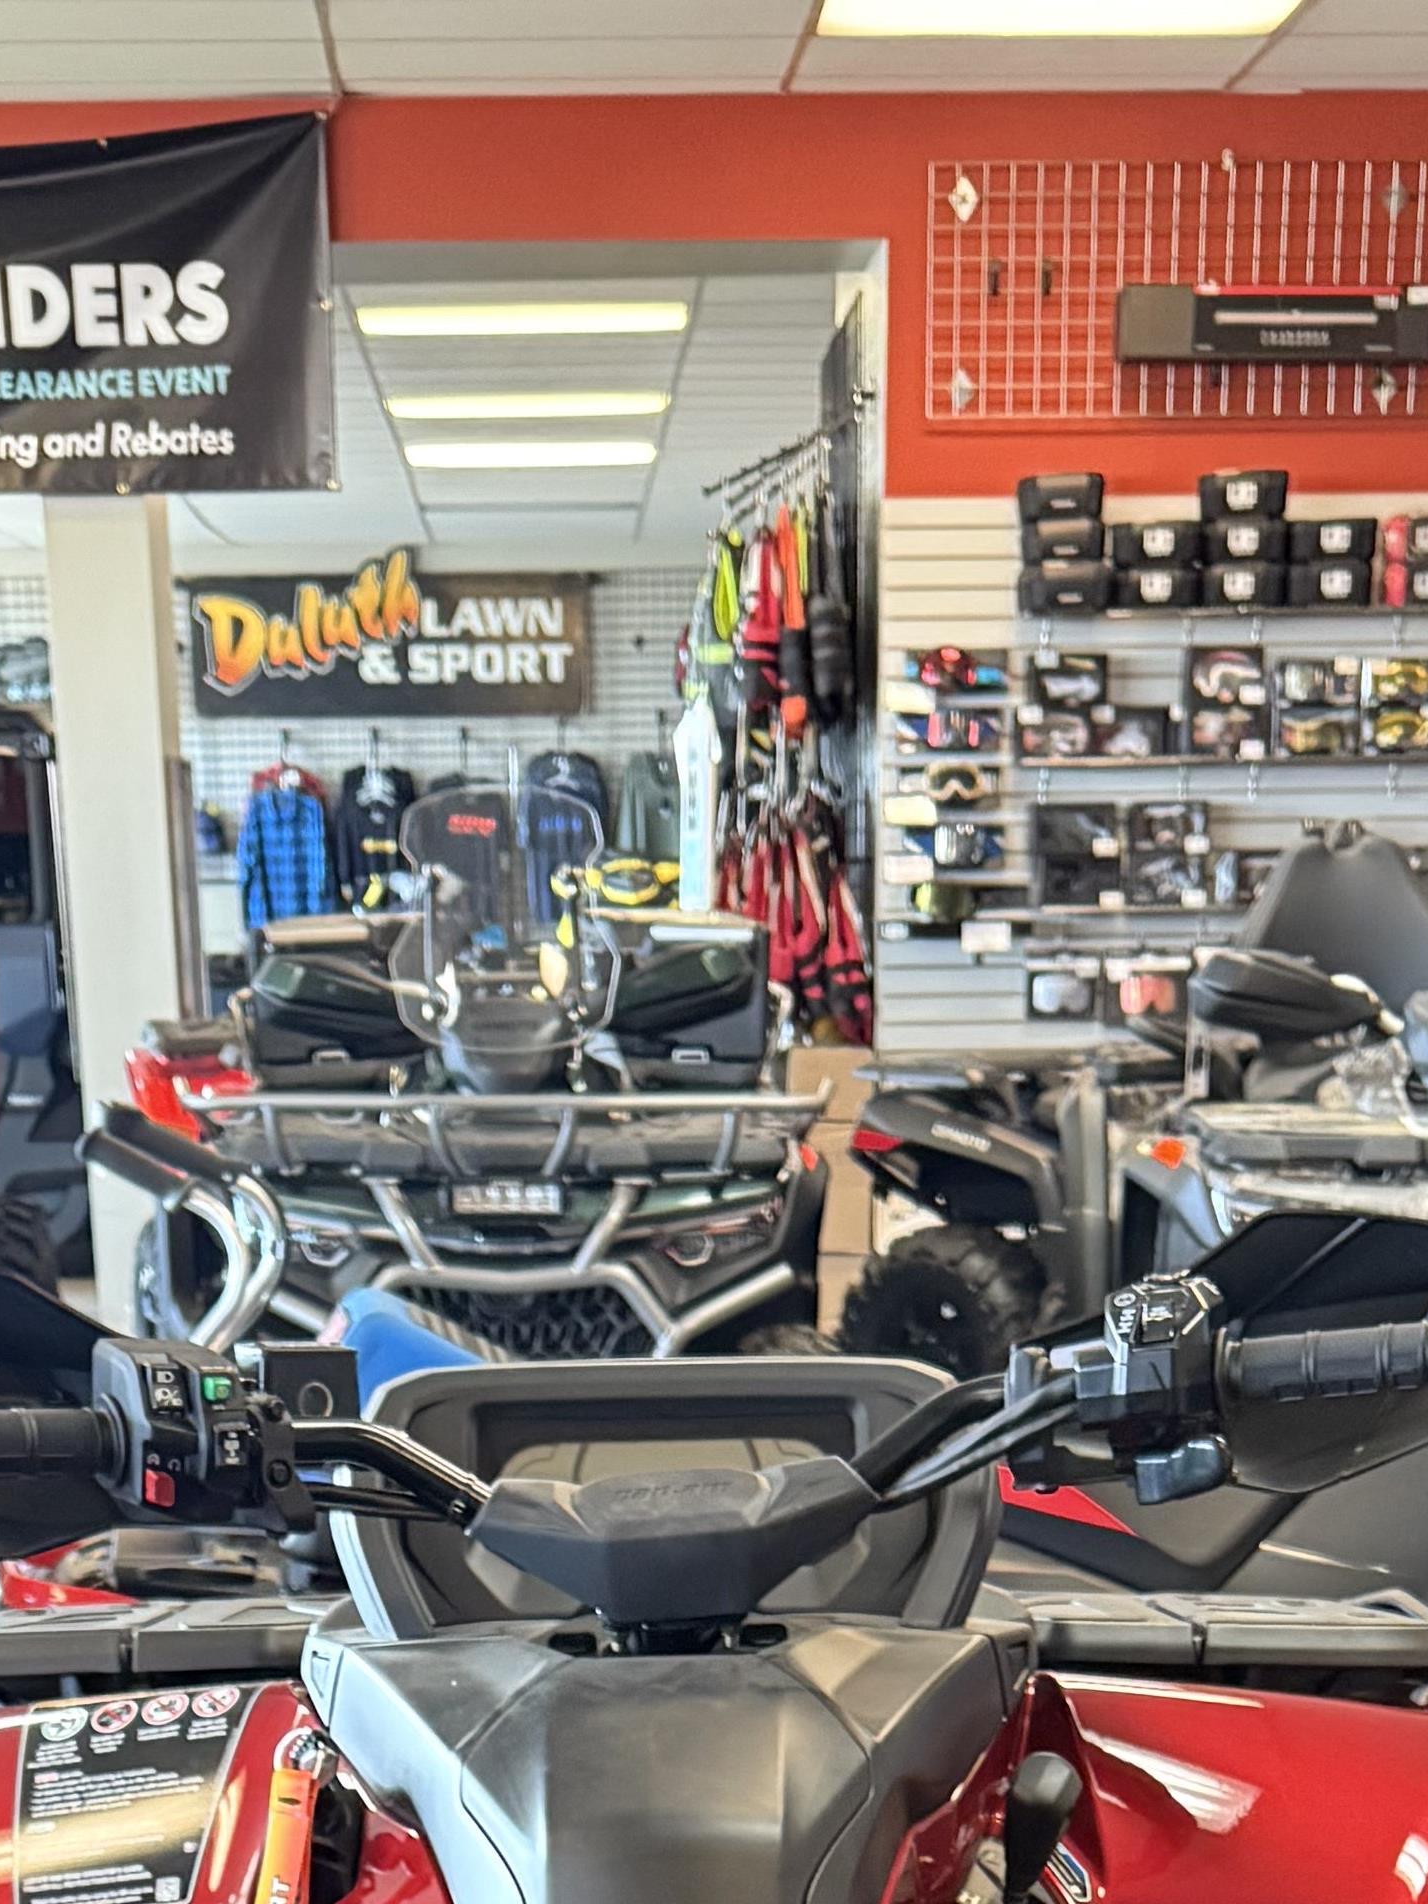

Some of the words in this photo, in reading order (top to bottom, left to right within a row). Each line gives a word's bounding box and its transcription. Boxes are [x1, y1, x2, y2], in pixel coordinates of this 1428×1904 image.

[137, 365, 231, 398] EVENT
[42, 421, 106, 459] and
[110, 419, 236, 458] Rebates
[198, 547, 420, 688] Duluth
[419, 596, 564, 639] LAWN
[358, 641, 400, 687] &
[407, 641, 573, 687] SPORT
